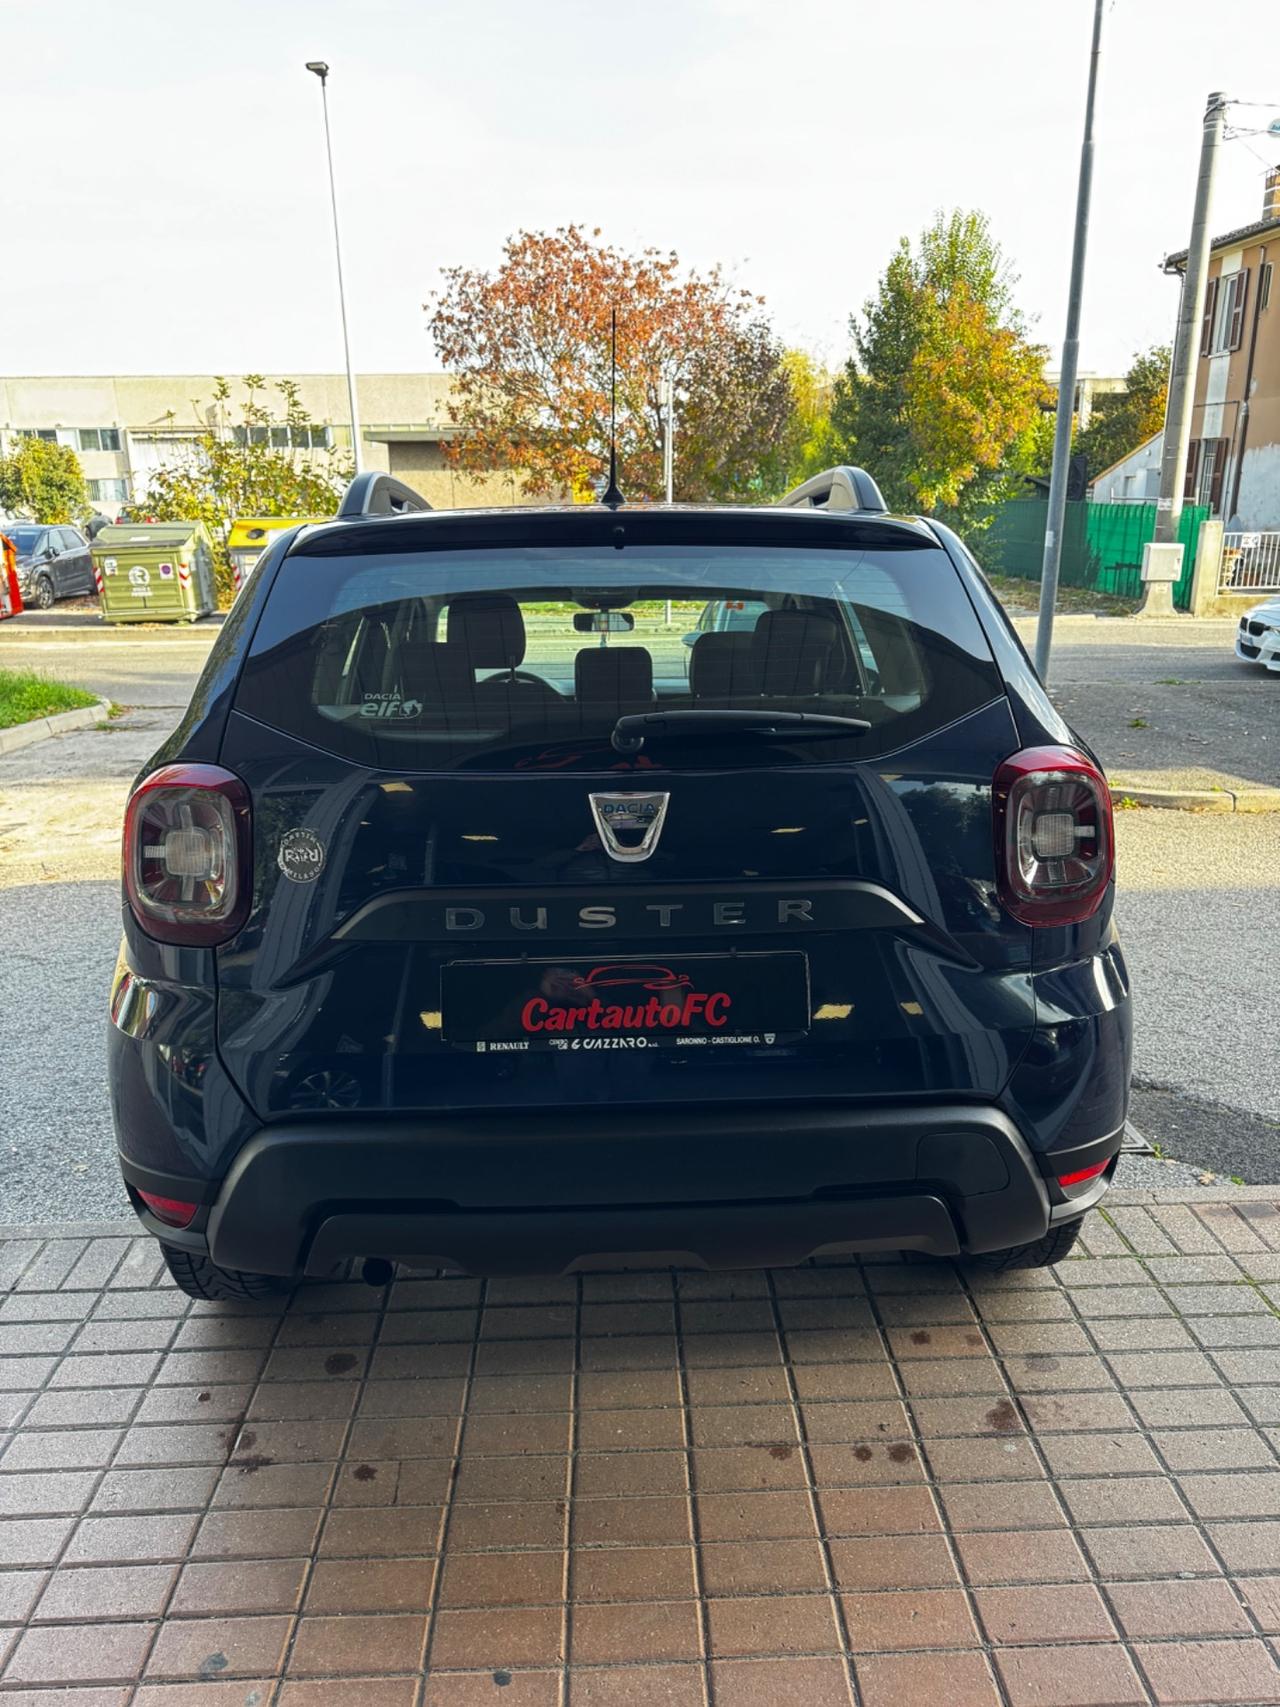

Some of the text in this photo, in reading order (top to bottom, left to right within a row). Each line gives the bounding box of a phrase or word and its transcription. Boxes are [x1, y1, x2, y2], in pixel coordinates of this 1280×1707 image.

[603, 803, 656, 813] DACIA
[445, 900, 814, 930] DUSTER
[521, 992, 731, 1032] CartautoFC
[489, 1041, 529, 1051] RENAULT
